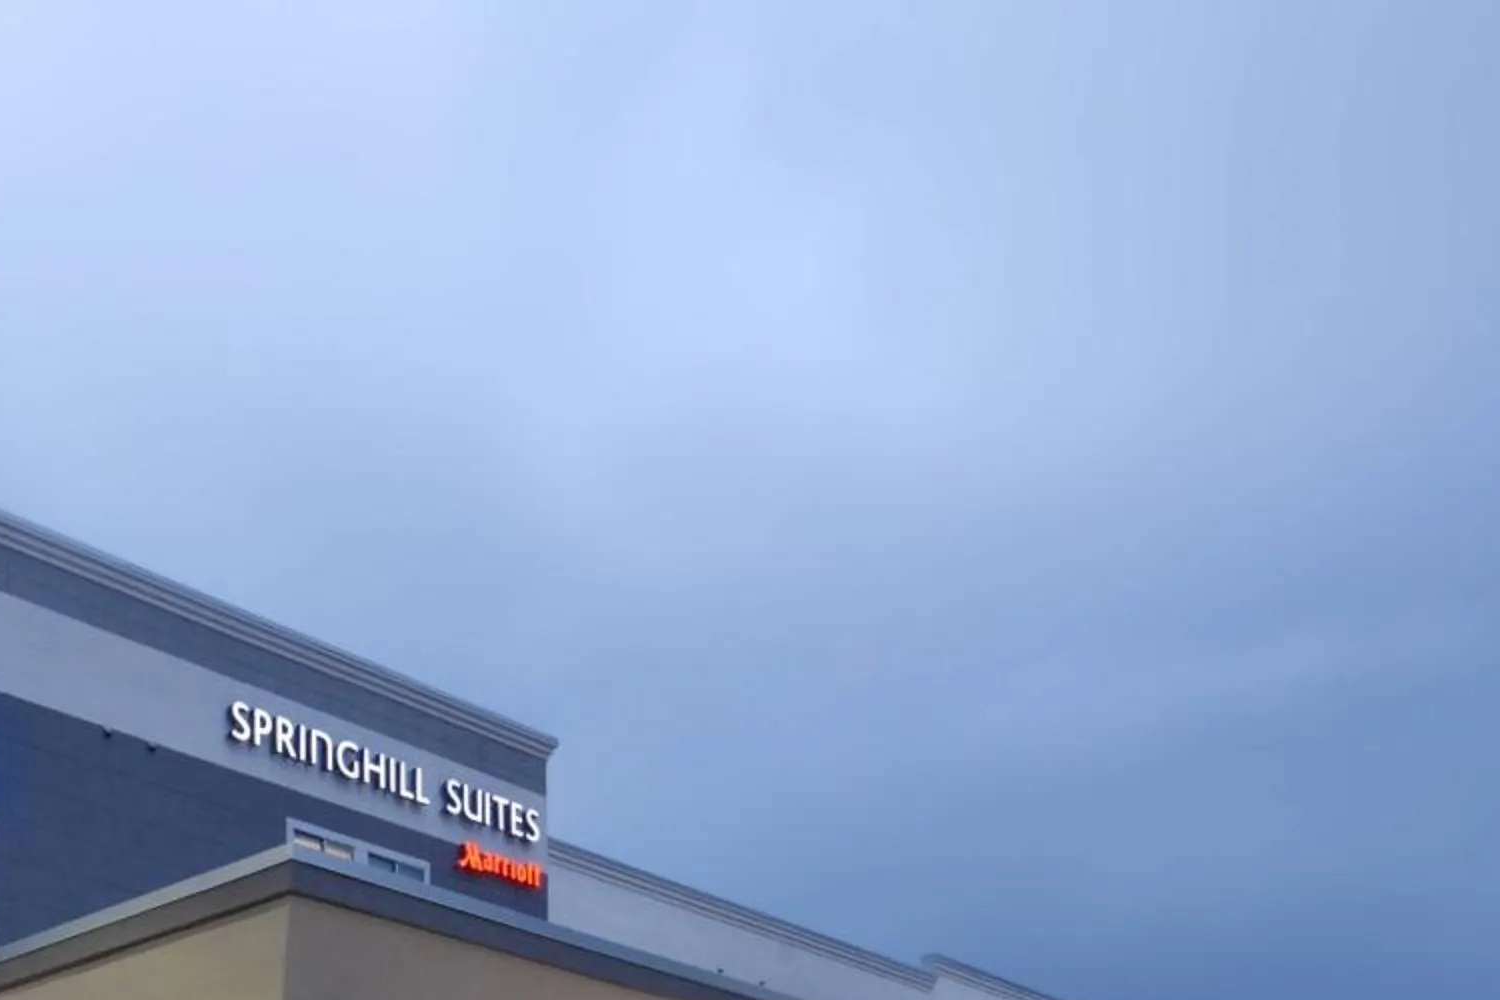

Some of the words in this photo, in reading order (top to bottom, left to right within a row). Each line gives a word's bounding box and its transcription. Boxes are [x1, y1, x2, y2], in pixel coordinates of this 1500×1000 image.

[230, 701, 431, 806] SPRINGHILL
[444, 778, 541, 842] SUITES
[457, 839, 544, 888] Marriott
